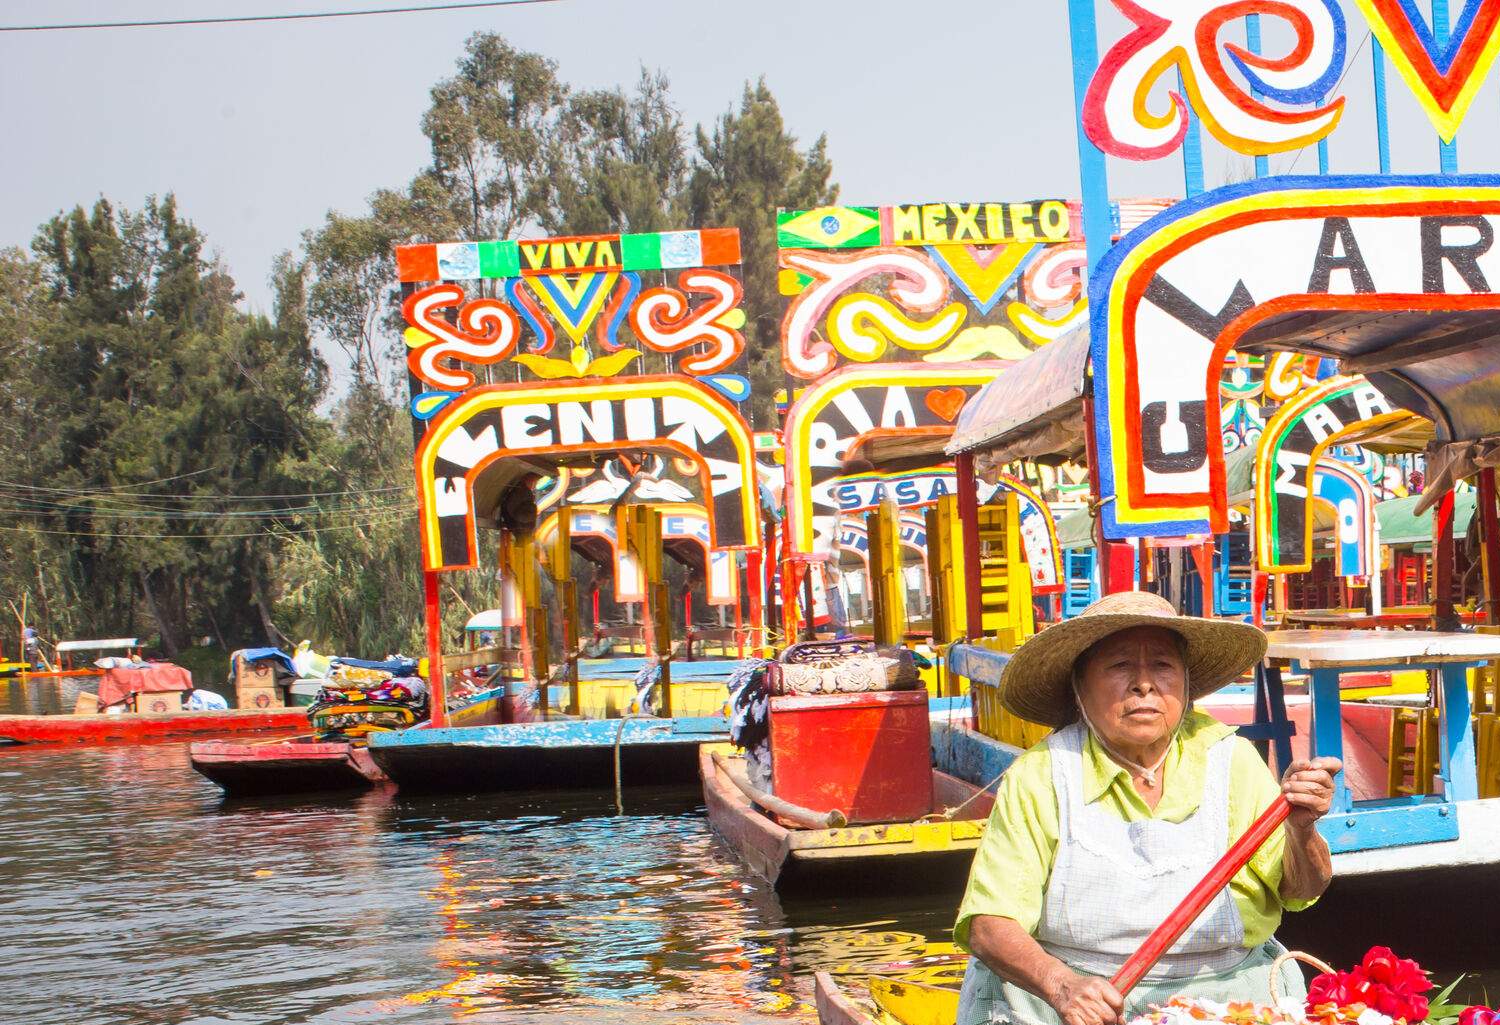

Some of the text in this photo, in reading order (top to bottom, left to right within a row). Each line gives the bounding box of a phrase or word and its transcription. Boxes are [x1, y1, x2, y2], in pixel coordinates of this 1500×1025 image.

[893, 201, 1071, 241] MEXICO
[520, 240, 616, 271] VIVA
[434, 396, 742, 517] ELENITA
